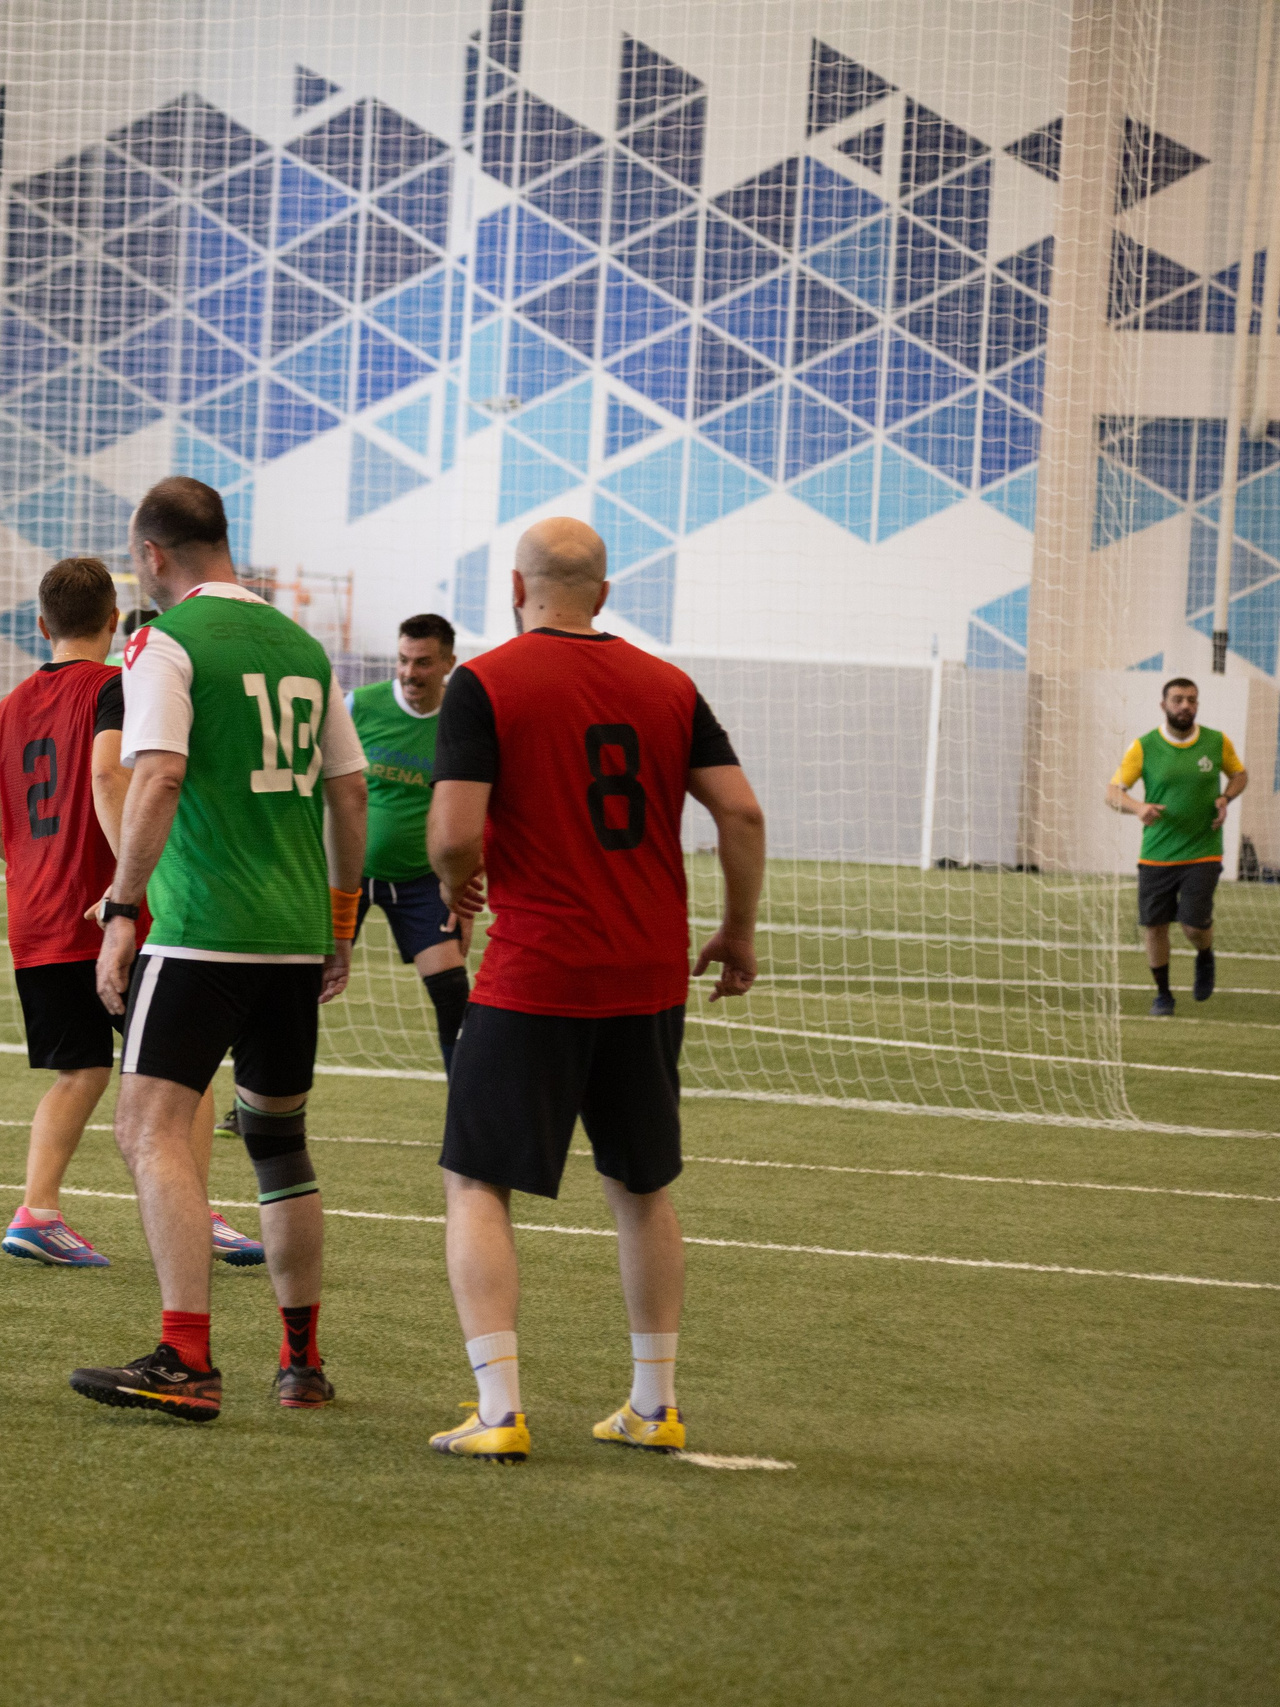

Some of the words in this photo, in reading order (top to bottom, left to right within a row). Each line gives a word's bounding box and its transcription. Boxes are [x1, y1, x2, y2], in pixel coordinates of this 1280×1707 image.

[23, 737, 60, 840] 2
[242, 673, 324, 796] 10
[585, 724, 646, 850] 8
